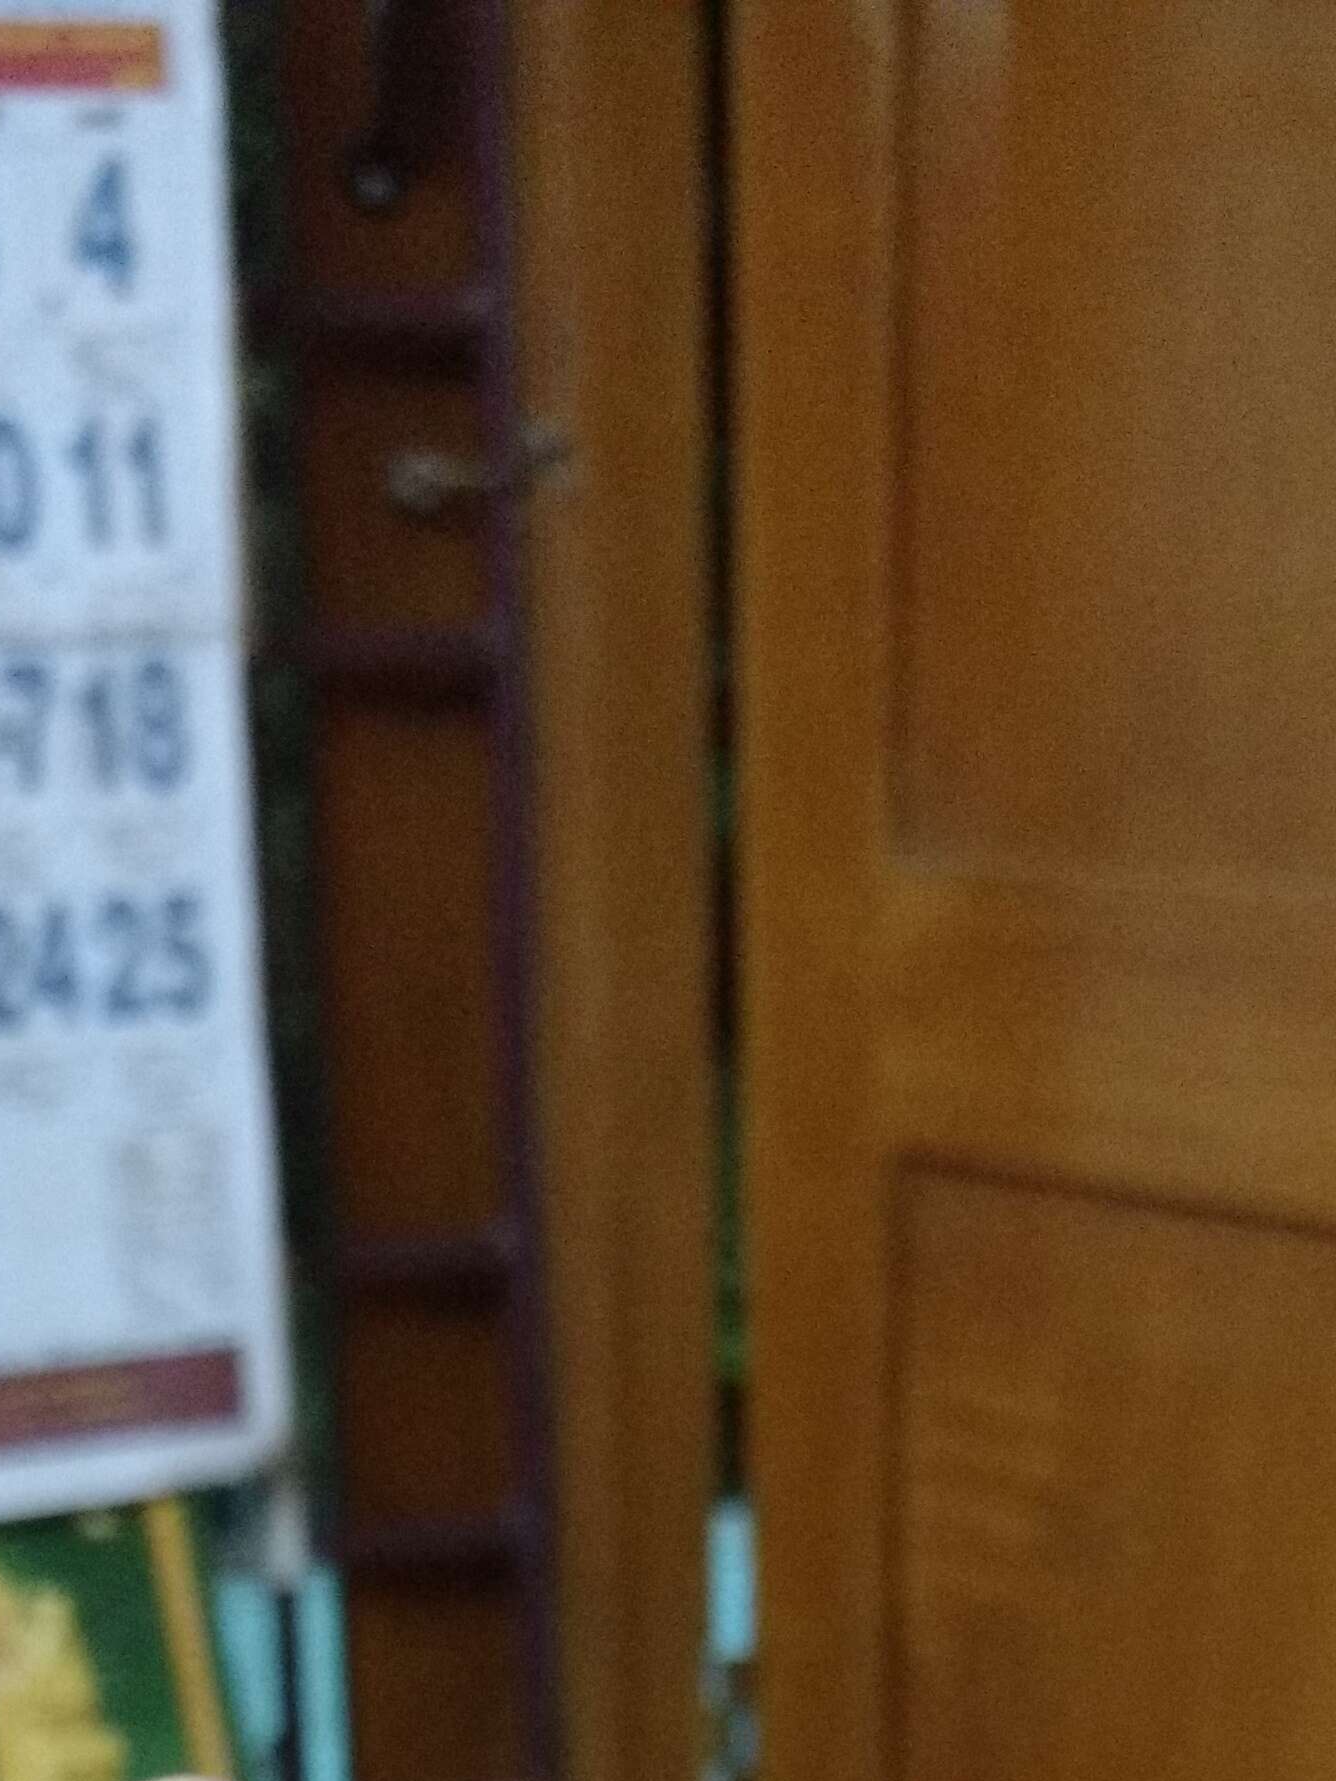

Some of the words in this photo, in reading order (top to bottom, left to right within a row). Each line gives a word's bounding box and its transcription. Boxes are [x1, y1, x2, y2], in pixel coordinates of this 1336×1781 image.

[72, 156, 138, 292] 4
[63, 413, 168, 544] 11
[74, 655, 190, 796] 18
[98, 890, 212, 1026] 25
